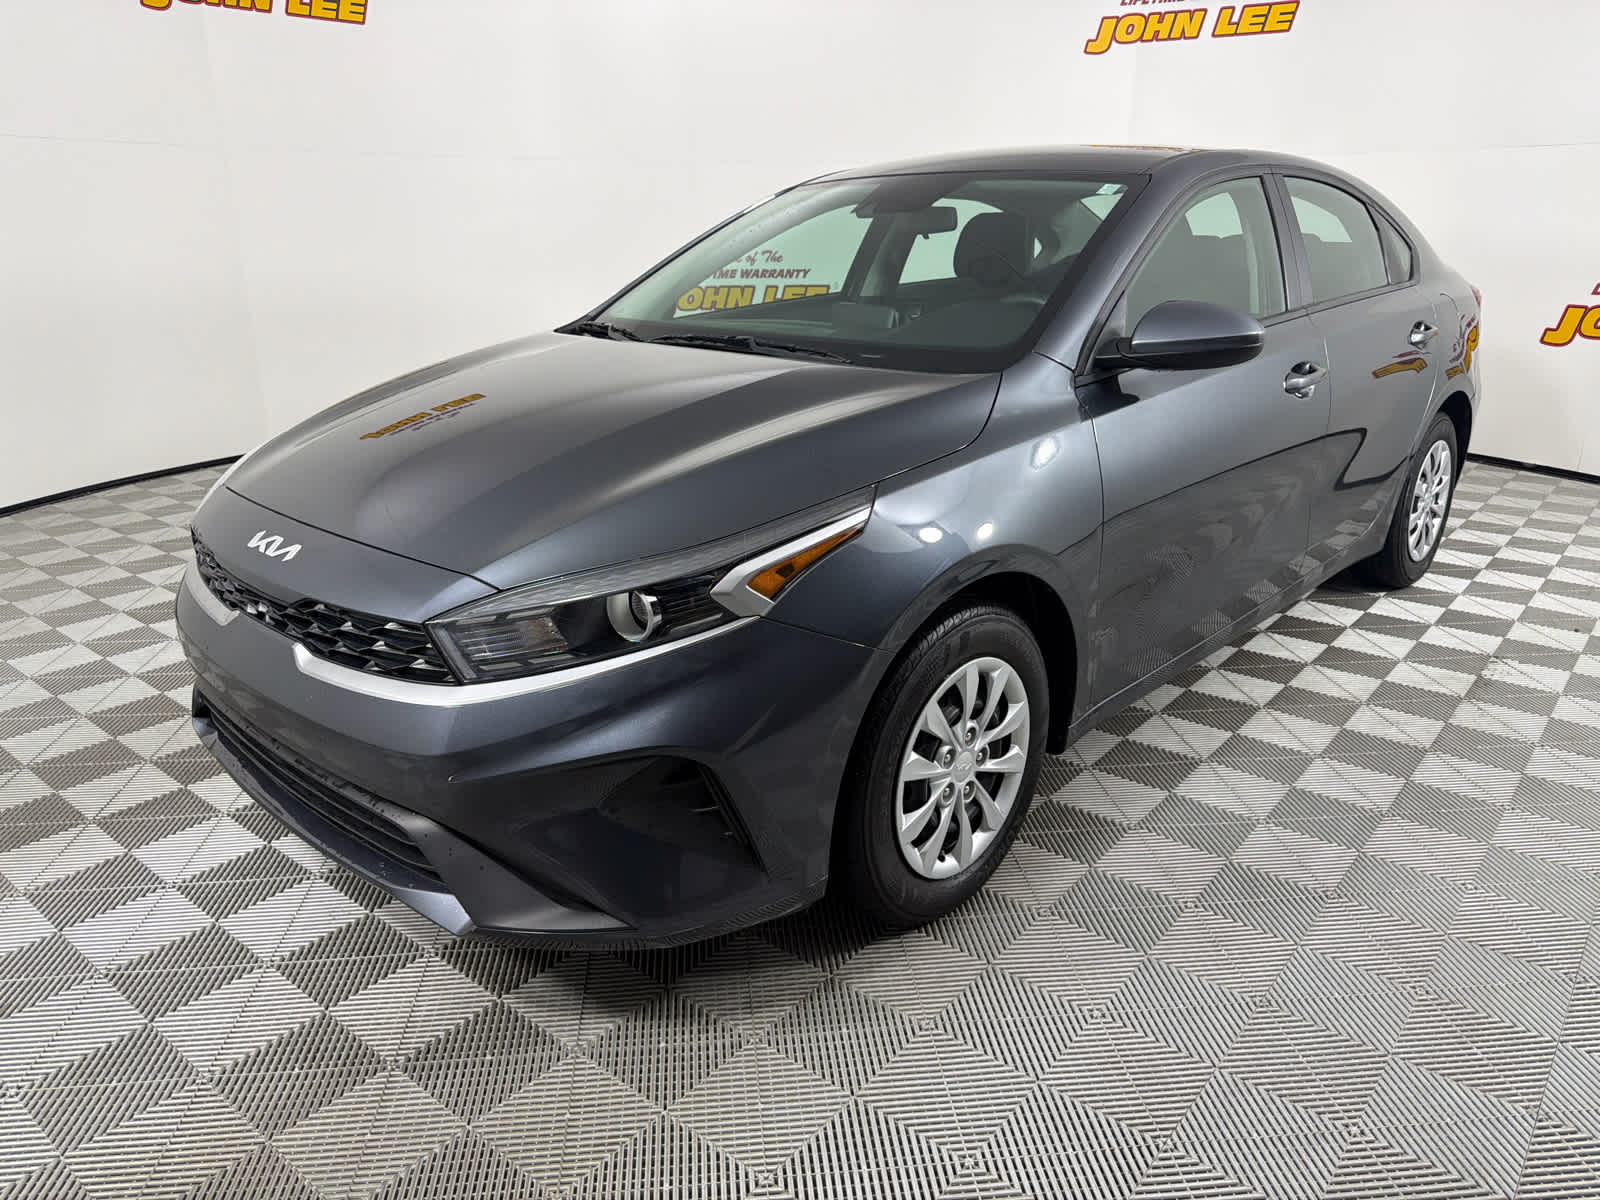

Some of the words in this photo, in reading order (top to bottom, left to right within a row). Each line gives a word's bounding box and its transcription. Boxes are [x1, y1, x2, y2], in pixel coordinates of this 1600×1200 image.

[1084, 8, 1207, 55] JOHN
[1211, 0, 1300, 37] LEE
[761, 250, 784, 264] The
[740, 268, 811, 279] WARRANTY
[677, 285, 755, 311] OHN
[247, 530, 302, 562] KIA
